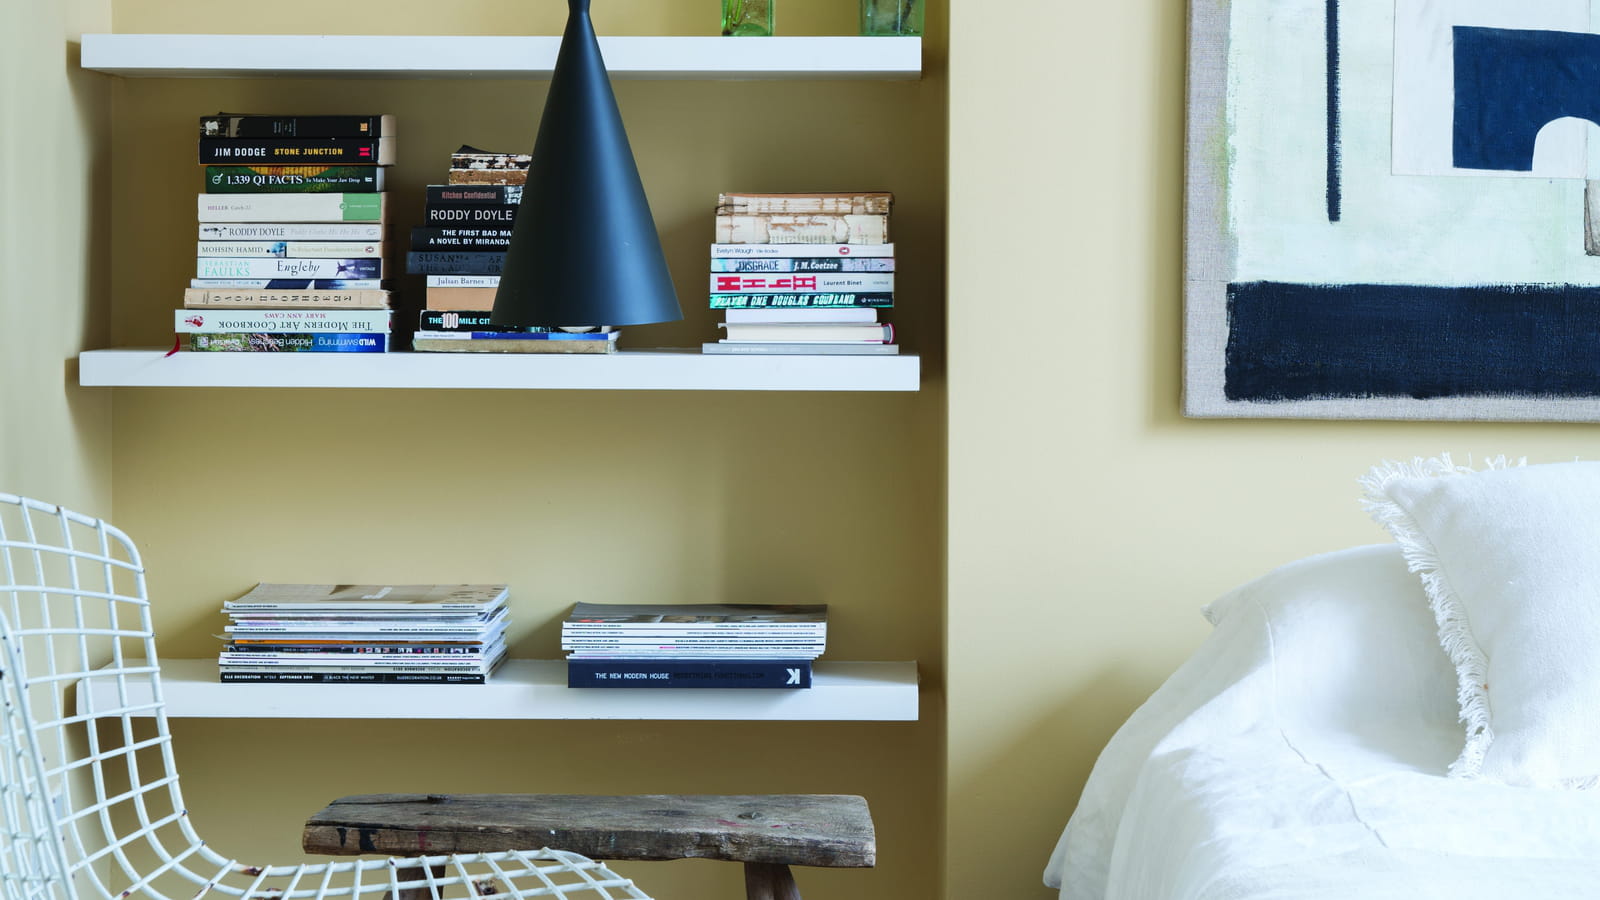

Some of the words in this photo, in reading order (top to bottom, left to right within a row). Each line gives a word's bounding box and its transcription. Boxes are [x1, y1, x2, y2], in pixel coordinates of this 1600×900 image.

[214, 147, 231, 157] JIM
[234, 147, 266, 157] DODGE
[253, 175, 266, 186] QI
[268, 175, 303, 185] FACTS
[348, 177, 361, 186] Drop
[441, 191, 463, 200] Kitchen
[463, 191, 497, 200] Confidential
[430, 209, 471, 221] RODDY
[474, 209, 513, 221] DOYLE
[229, 227, 258, 237] RODDY
[259, 227, 285, 237] DOYLE
[458, 229, 480, 237] FIRST
[475, 238, 510, 246] MIRANDA
[716, 247, 734, 255] Evelyn
[734, 247, 754, 255] Waugh
[277, 260, 320, 276] Engleby
[737, 260, 780, 271] DISGRACE
[811, 261, 838, 270] Coetzee
[204, 267, 251, 277] FAULKS
[437, 276, 459, 286] Julian
[460, 277, 485, 285] Barnes
[713, 295, 749, 307] PLAYER
[750, 295, 768, 307] ONE
[771, 295, 810, 307] DOUGLAS
[813, 294, 856, 306] COUPLAND
[428, 317, 442, 325] THE
[441, 312, 459, 329] 100
[459, 317, 478, 325] MILE
[250, 337, 285, 347] Beaches
[285, 337, 313, 347] Hidden
[594, 672, 608, 680] THE
[609, 672, 622, 680] NEW
[623, 672, 648, 680] MODERN
[649, 672, 670, 680] HOUSE
